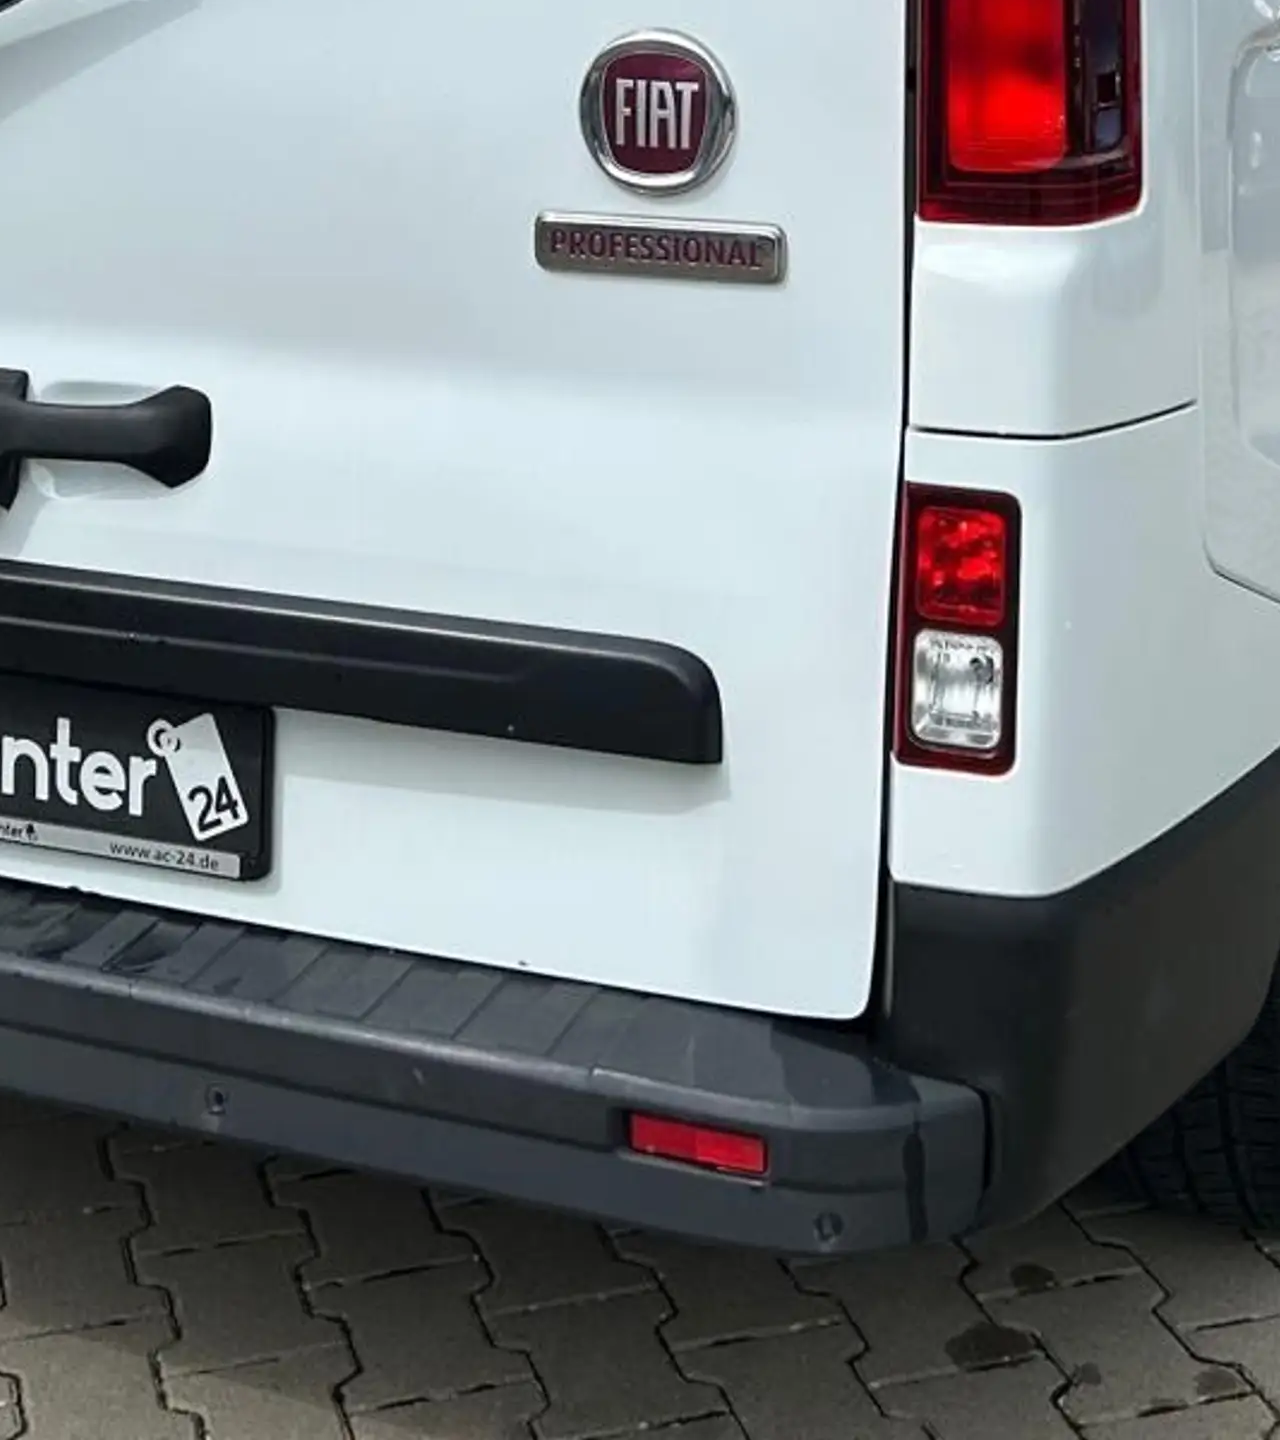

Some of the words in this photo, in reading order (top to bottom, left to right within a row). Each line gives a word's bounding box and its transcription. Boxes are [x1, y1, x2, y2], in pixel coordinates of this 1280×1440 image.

[615, 77, 700, 150] FIAT
[550, 228, 763, 268] PROFESSIONAL
[187, 775, 240, 833] 24
[109, 841, 220, 871] www.ac-24.de
